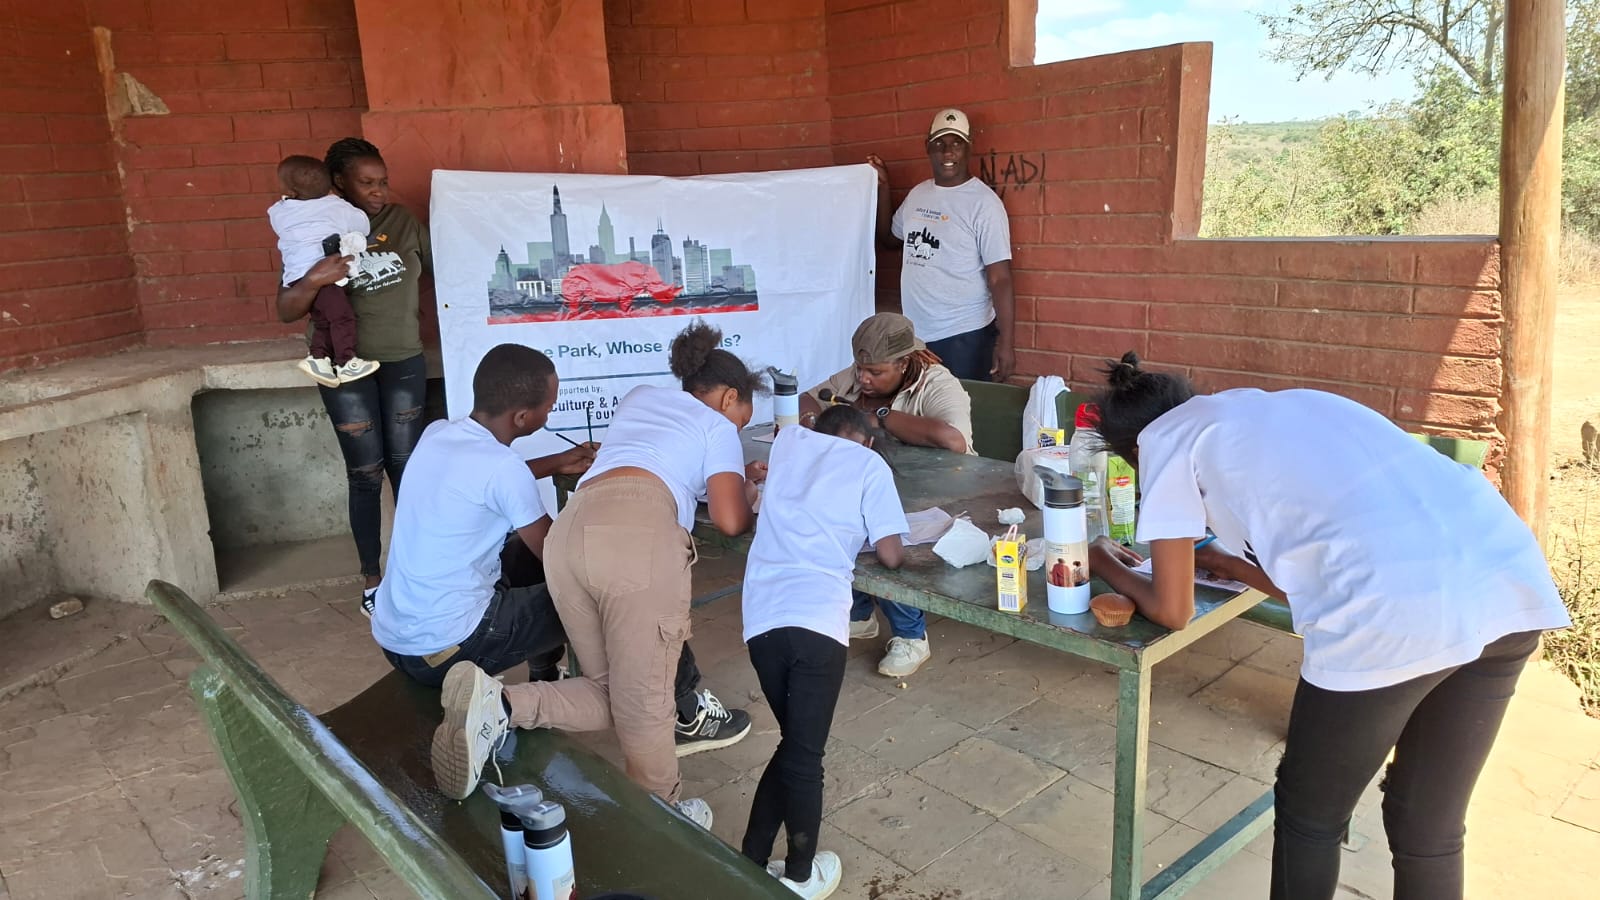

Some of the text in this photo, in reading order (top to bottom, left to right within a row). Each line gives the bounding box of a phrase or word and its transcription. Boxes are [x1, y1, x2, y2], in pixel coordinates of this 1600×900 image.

[558, 343, 601, 358] Park,
[606, 340, 662, 355] Whose
[559, 386, 589, 395] pported
[599, 397, 608, 408] &
